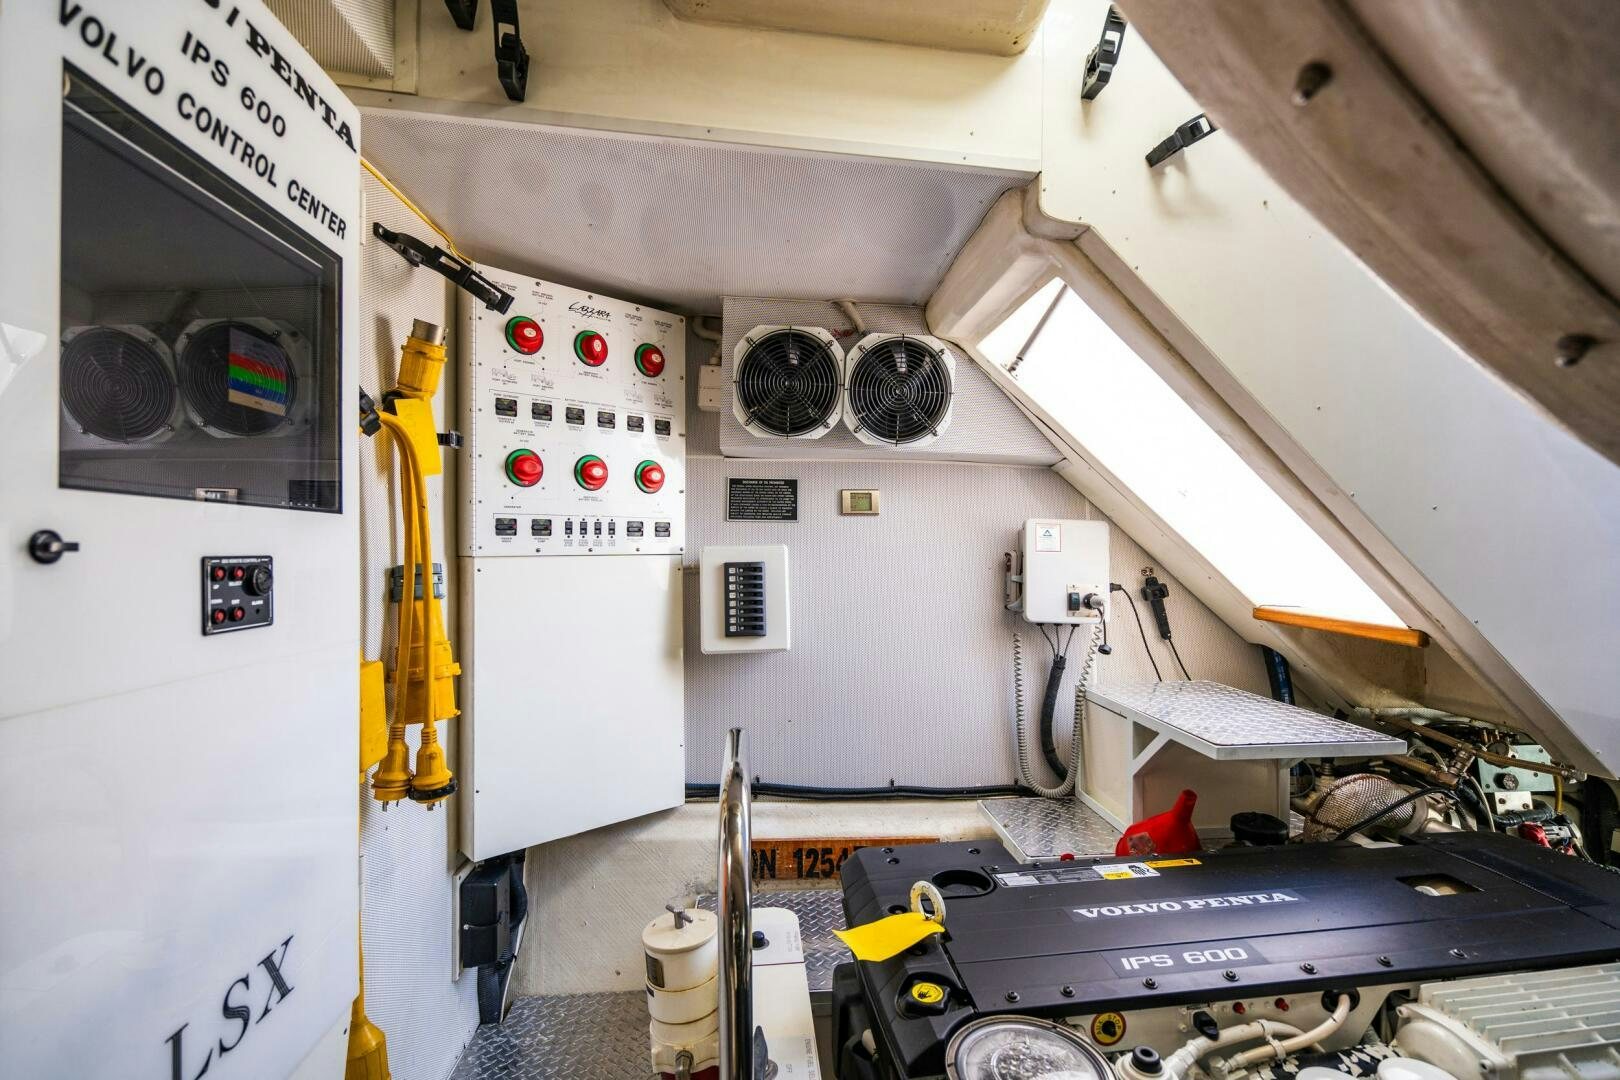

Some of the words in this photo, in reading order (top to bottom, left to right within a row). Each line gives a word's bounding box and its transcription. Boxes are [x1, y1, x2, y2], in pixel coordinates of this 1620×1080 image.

[58, 0, 165, 96] VOLVO
[177, 92, 277, 188] CONTROL
[287, 179, 347, 240] CENTER
[181, 31, 230, 87] IPS
[240, 87, 286, 138] 600
[245, 19, 357, 154] PENTA
[1074, 902, 1183, 918] VOLVO
[1183, 893, 1299, 910] PENTA
[1122, 955, 1174, 970] IPS
[1184, 948, 1249, 964] 600
